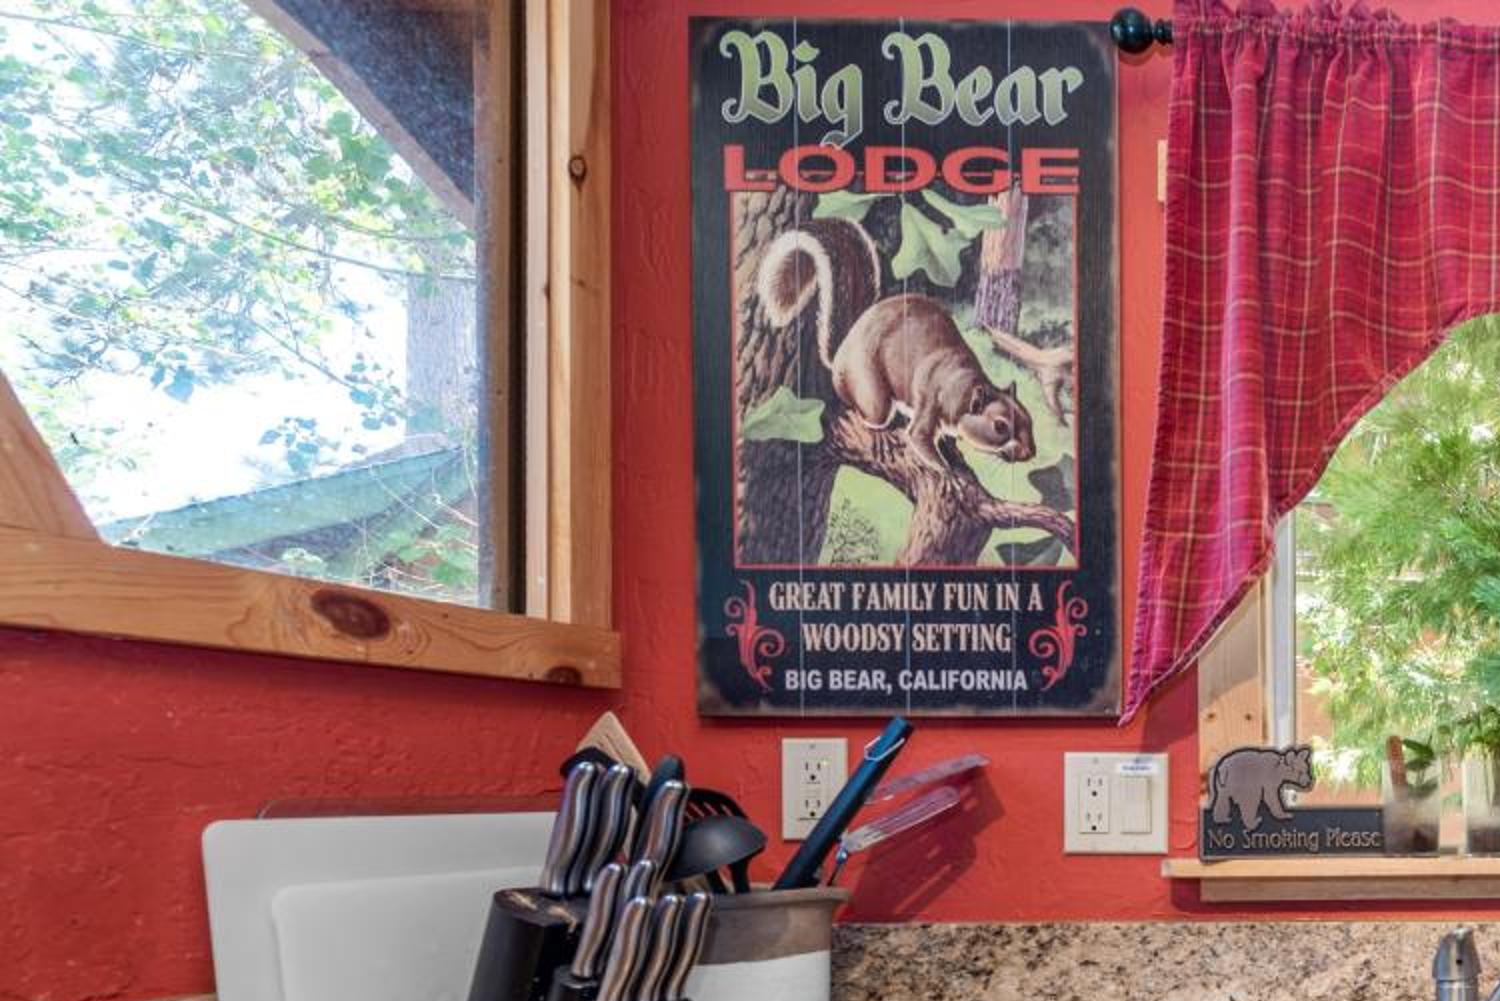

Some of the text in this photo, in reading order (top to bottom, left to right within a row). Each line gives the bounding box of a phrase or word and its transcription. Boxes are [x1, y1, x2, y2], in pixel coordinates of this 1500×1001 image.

[719, 30, 1084, 150] Big Bear
[723, 144, 1081, 194] LODGE
[768, 581, 1044, 611] GREAT FAMILY FUN IN A
[802, 623, 1012, 652] WOODSY SETTING
[785, 670, 1028, 695] BIG BEAR, CALIFORNIA
[1208, 827, 1382, 853] No Smoking Please
